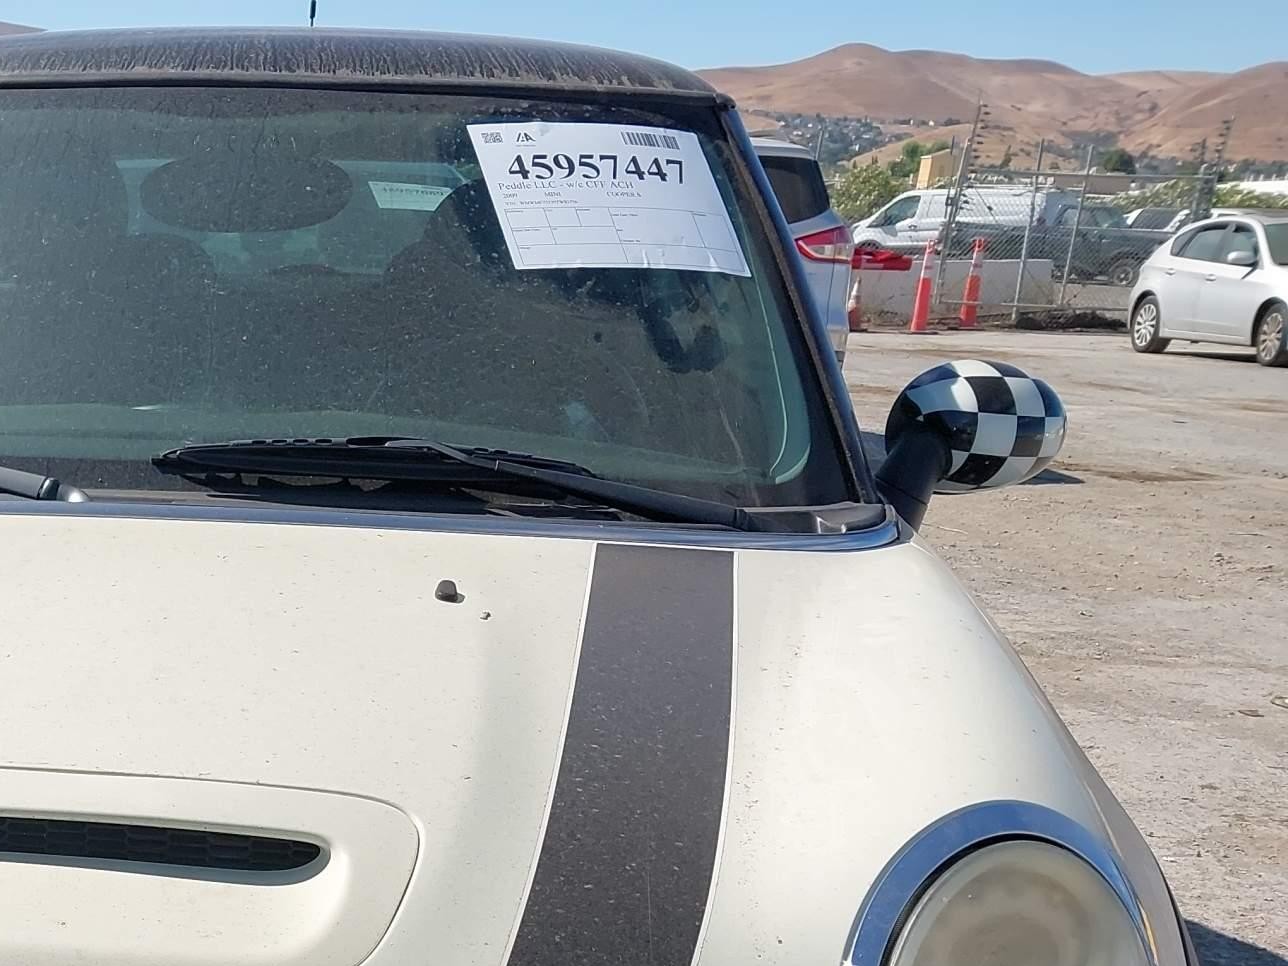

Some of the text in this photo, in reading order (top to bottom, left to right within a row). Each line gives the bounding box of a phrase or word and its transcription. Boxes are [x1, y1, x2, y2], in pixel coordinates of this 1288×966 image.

[508, 153, 683, 184] 45957447
[498, 182, 532, 191] Peddle
[534, 181, 556, 190] LLC
[610, 181, 634, 189] ACH
